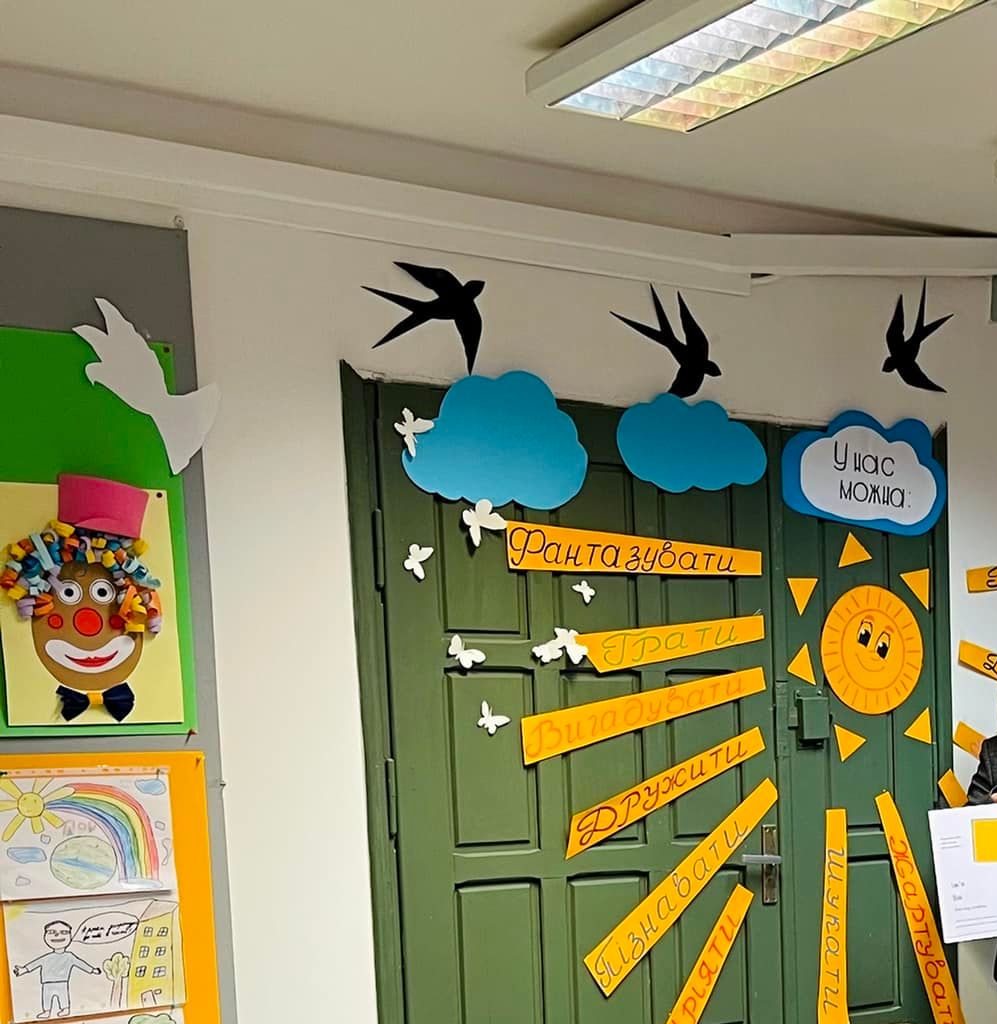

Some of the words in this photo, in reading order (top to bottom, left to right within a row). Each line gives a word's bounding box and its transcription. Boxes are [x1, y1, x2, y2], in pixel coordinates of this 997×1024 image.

[834, 440, 849, 471] У
[853, 452, 895, 477] нас
[839, 479, 911, 509] можна:
[509, 526, 737, 573] Фантазувати
[601, 624, 739, 668] Грати
[525, 675, 745, 757] Вигадувати
[576, 740, 749, 847] Дружити
[594, 819, 749, 990] Пізнавати
[823, 846, 845, 1015] Шукати
